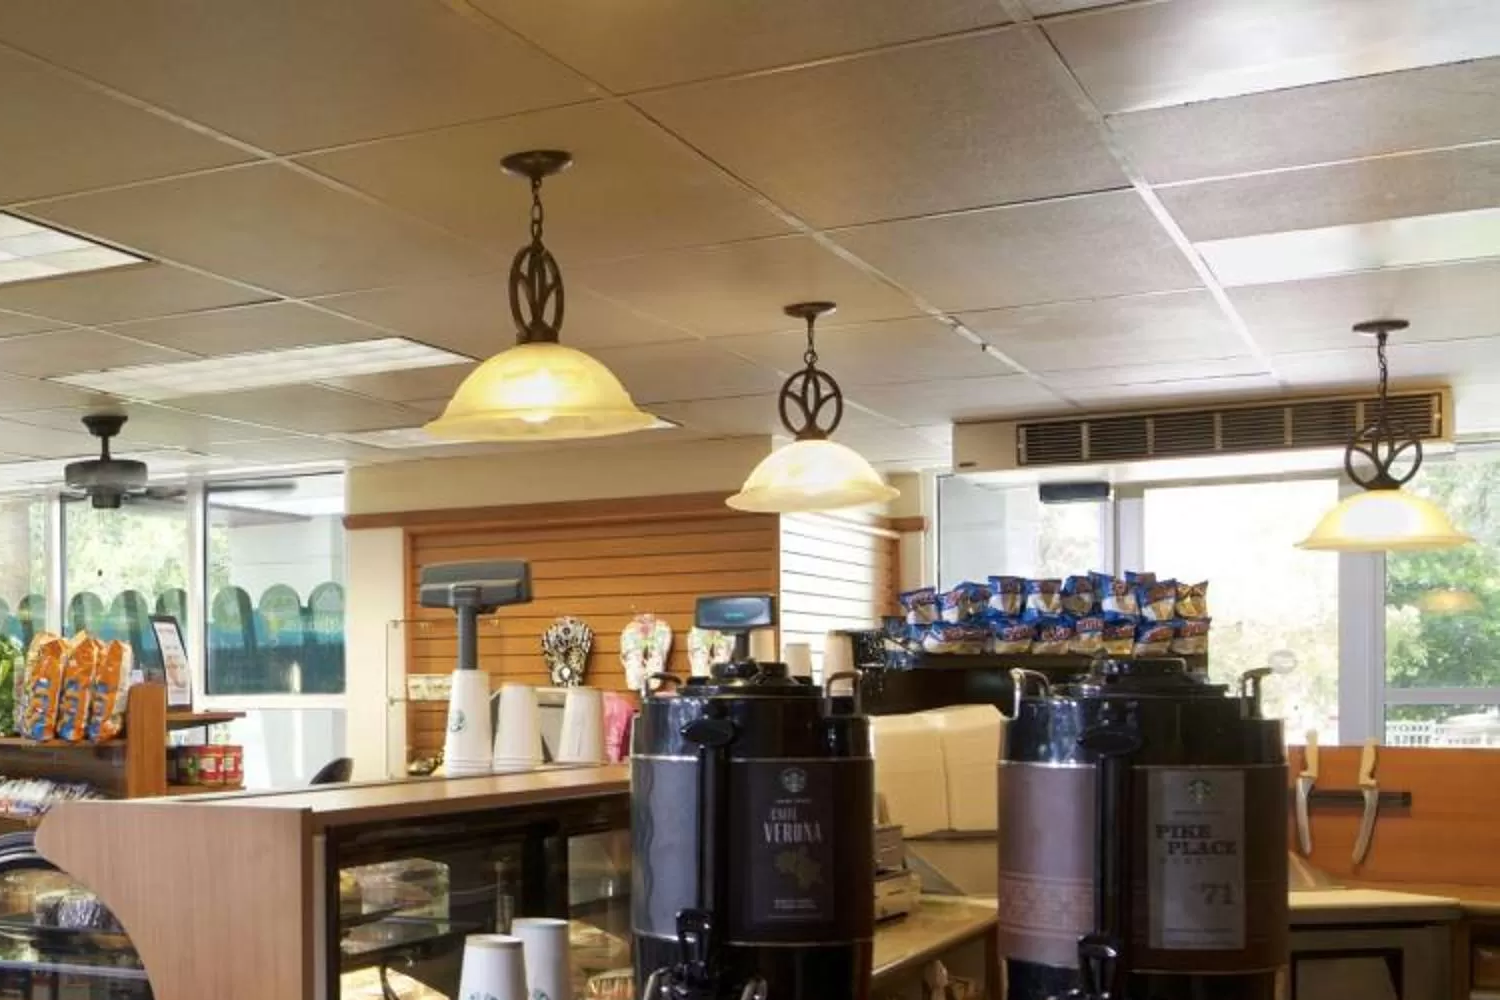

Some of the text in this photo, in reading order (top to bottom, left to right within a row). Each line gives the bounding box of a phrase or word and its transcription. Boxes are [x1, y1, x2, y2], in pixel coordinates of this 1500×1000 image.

[763, 820, 822, 844] VERONA
[1155, 823, 1212, 840] PIKE
[1167, 839, 1237, 857] PLACE
